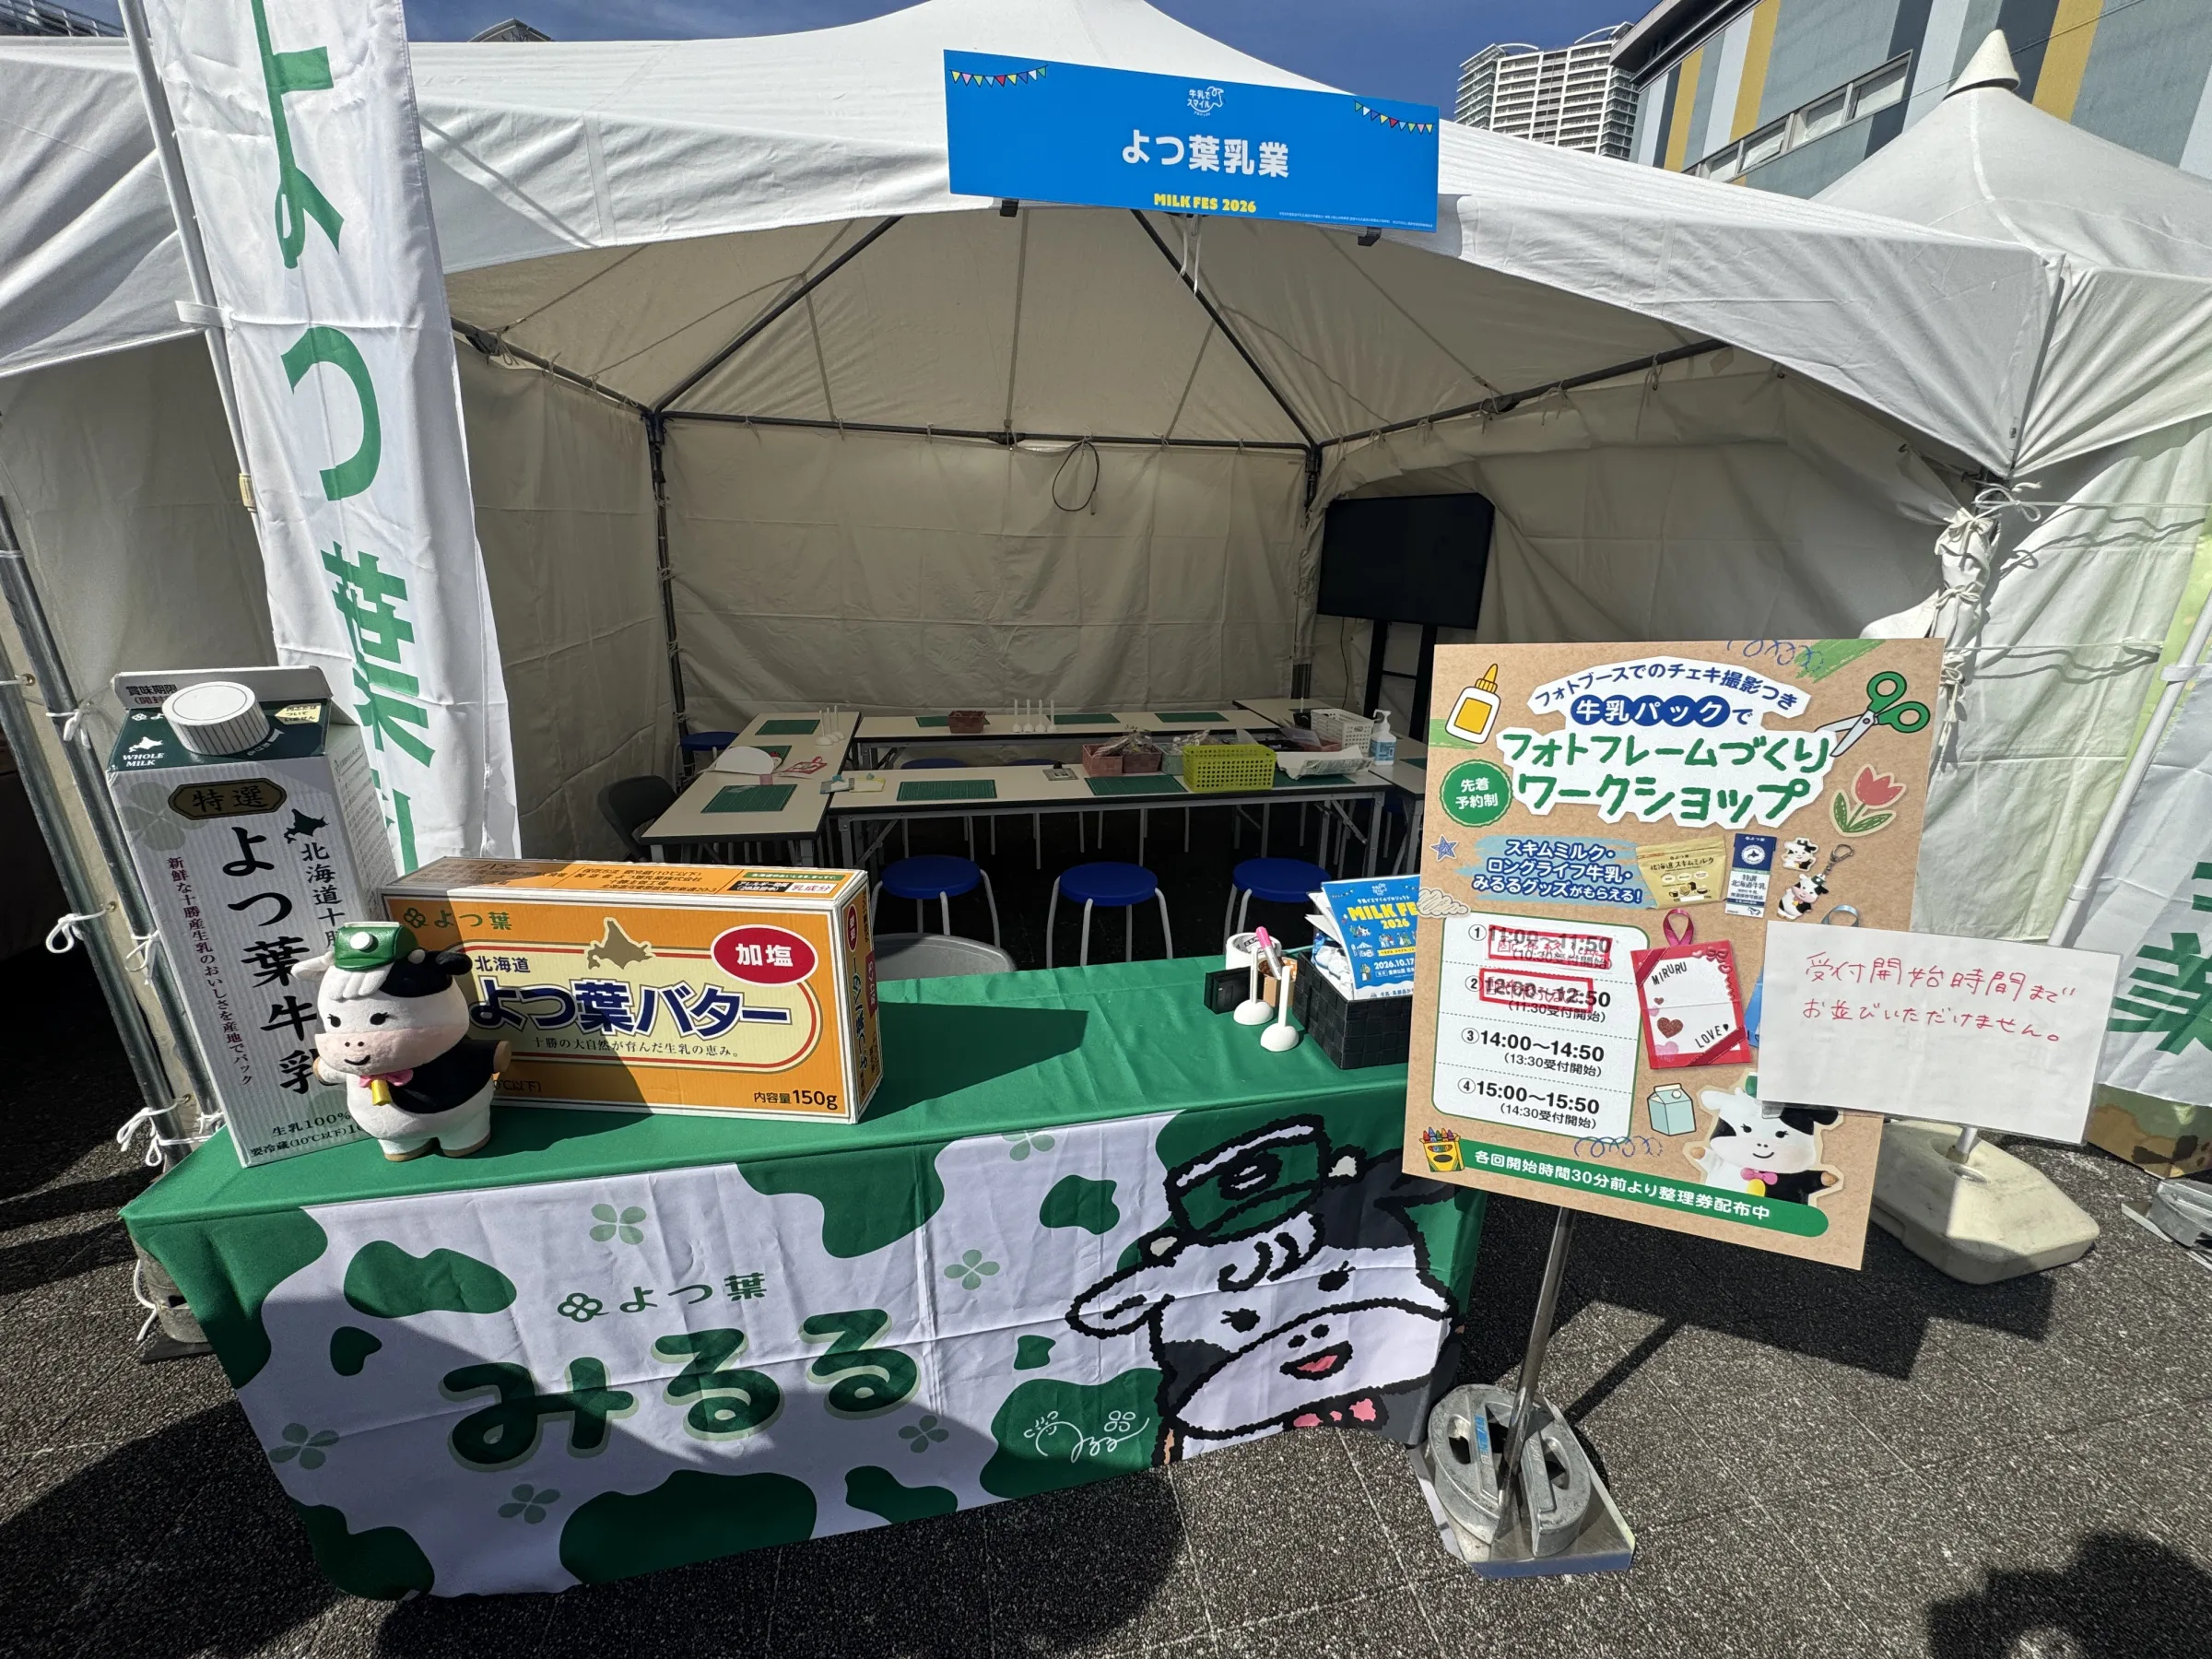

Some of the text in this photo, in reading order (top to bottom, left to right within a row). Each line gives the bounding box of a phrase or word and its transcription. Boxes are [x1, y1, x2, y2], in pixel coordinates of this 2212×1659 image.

[1122, 129, 1289, 178] よつ葉乳業
[1154, 193, 1256, 213] MILK FES 2026
[1535, 664, 1798, 710] フォトブースでのチェキ撮影つき
[1575, 697, 1754, 726] 牛乳パックで
[123, 753, 165, 761] WHOLE
[126, 759, 156, 768] MILK
[1502, 733, 1830, 773] フォトフレームづくり
[1460, 776, 1490, 792] 先着
[192, 784, 269, 813] 特選
[1454, 793, 1499, 810] 予約制
[1519, 774, 1811, 823] ワークショップ
[1472, 875, 1641, 904] みるるグッズがもらえる!
[433, 909, 512, 931] よつ葉
[1347, 903, 1398, 922] MILK
[1381, 917, 1411, 930] 2026
[474, 955, 531, 974] 北海道
[736, 942, 794, 968] 加塩
[168, 856, 253, 1086] 新鮮な十勝産生乳のおいしさを産地でパック
[1651, 961, 1688, 986] MIRURU
[1806, 950, 2077, 1004] 受付開始時間まで
[469, 975, 794, 1041] よつ葉バター
[1802, 998, 2060, 1042] お並びいただけません。
[532, 1036, 740, 1058] 十勝の大自然が育んだ生乳の恵み。
[1694, 1025, 1723, 1049] LOVE
[1503, 1052, 1602, 1077] (13:30受付開始)
[272, 1112, 351, 1137] 生乳100%
[1500, 1102, 1597, 1130] (14:30受付開始)
[250, 1128, 347, 1158] 要冷蔵(10℃以下)
[1474, 1149, 1771, 1220] 各回開始時間30分前より整理券配布中
[619, 1272, 768, 1313] よつ葉
[439, 1308, 922, 1472] みるる
